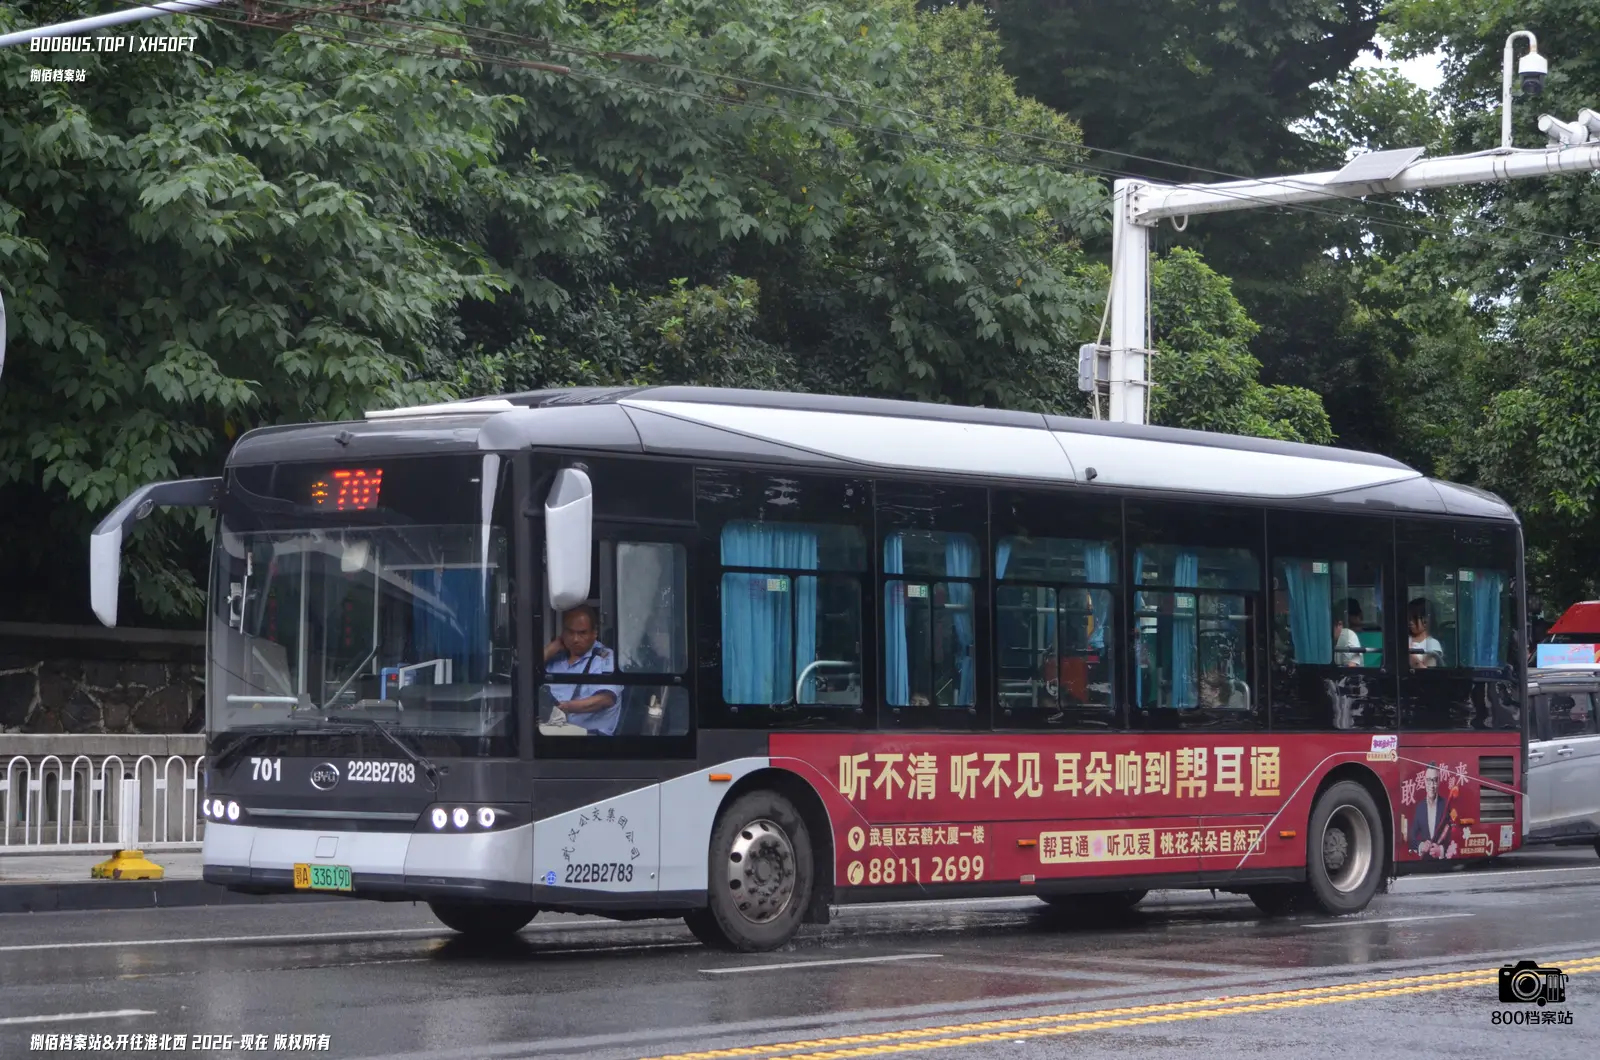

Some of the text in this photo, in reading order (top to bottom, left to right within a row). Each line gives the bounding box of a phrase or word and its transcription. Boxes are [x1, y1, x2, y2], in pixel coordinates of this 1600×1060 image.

[250, 757, 282, 782] 701
[347, 760, 416, 783] 222B2783
[839, 746, 1280, 802] 听不清 听不见 耳朵响到帮耳通
[561, 807, 641, 862] 武汉公交集团公司
[869, 825, 985, 847] 武昌区云鹤大厦一楼
[1043, 832, 1151, 859] 帮耳通 听见爱
[1159, 829, 1263, 855] 桃花朵朵自然开
[565, 863, 634, 883] 222B2783
[868, 855, 985, 884] 8811 2699
